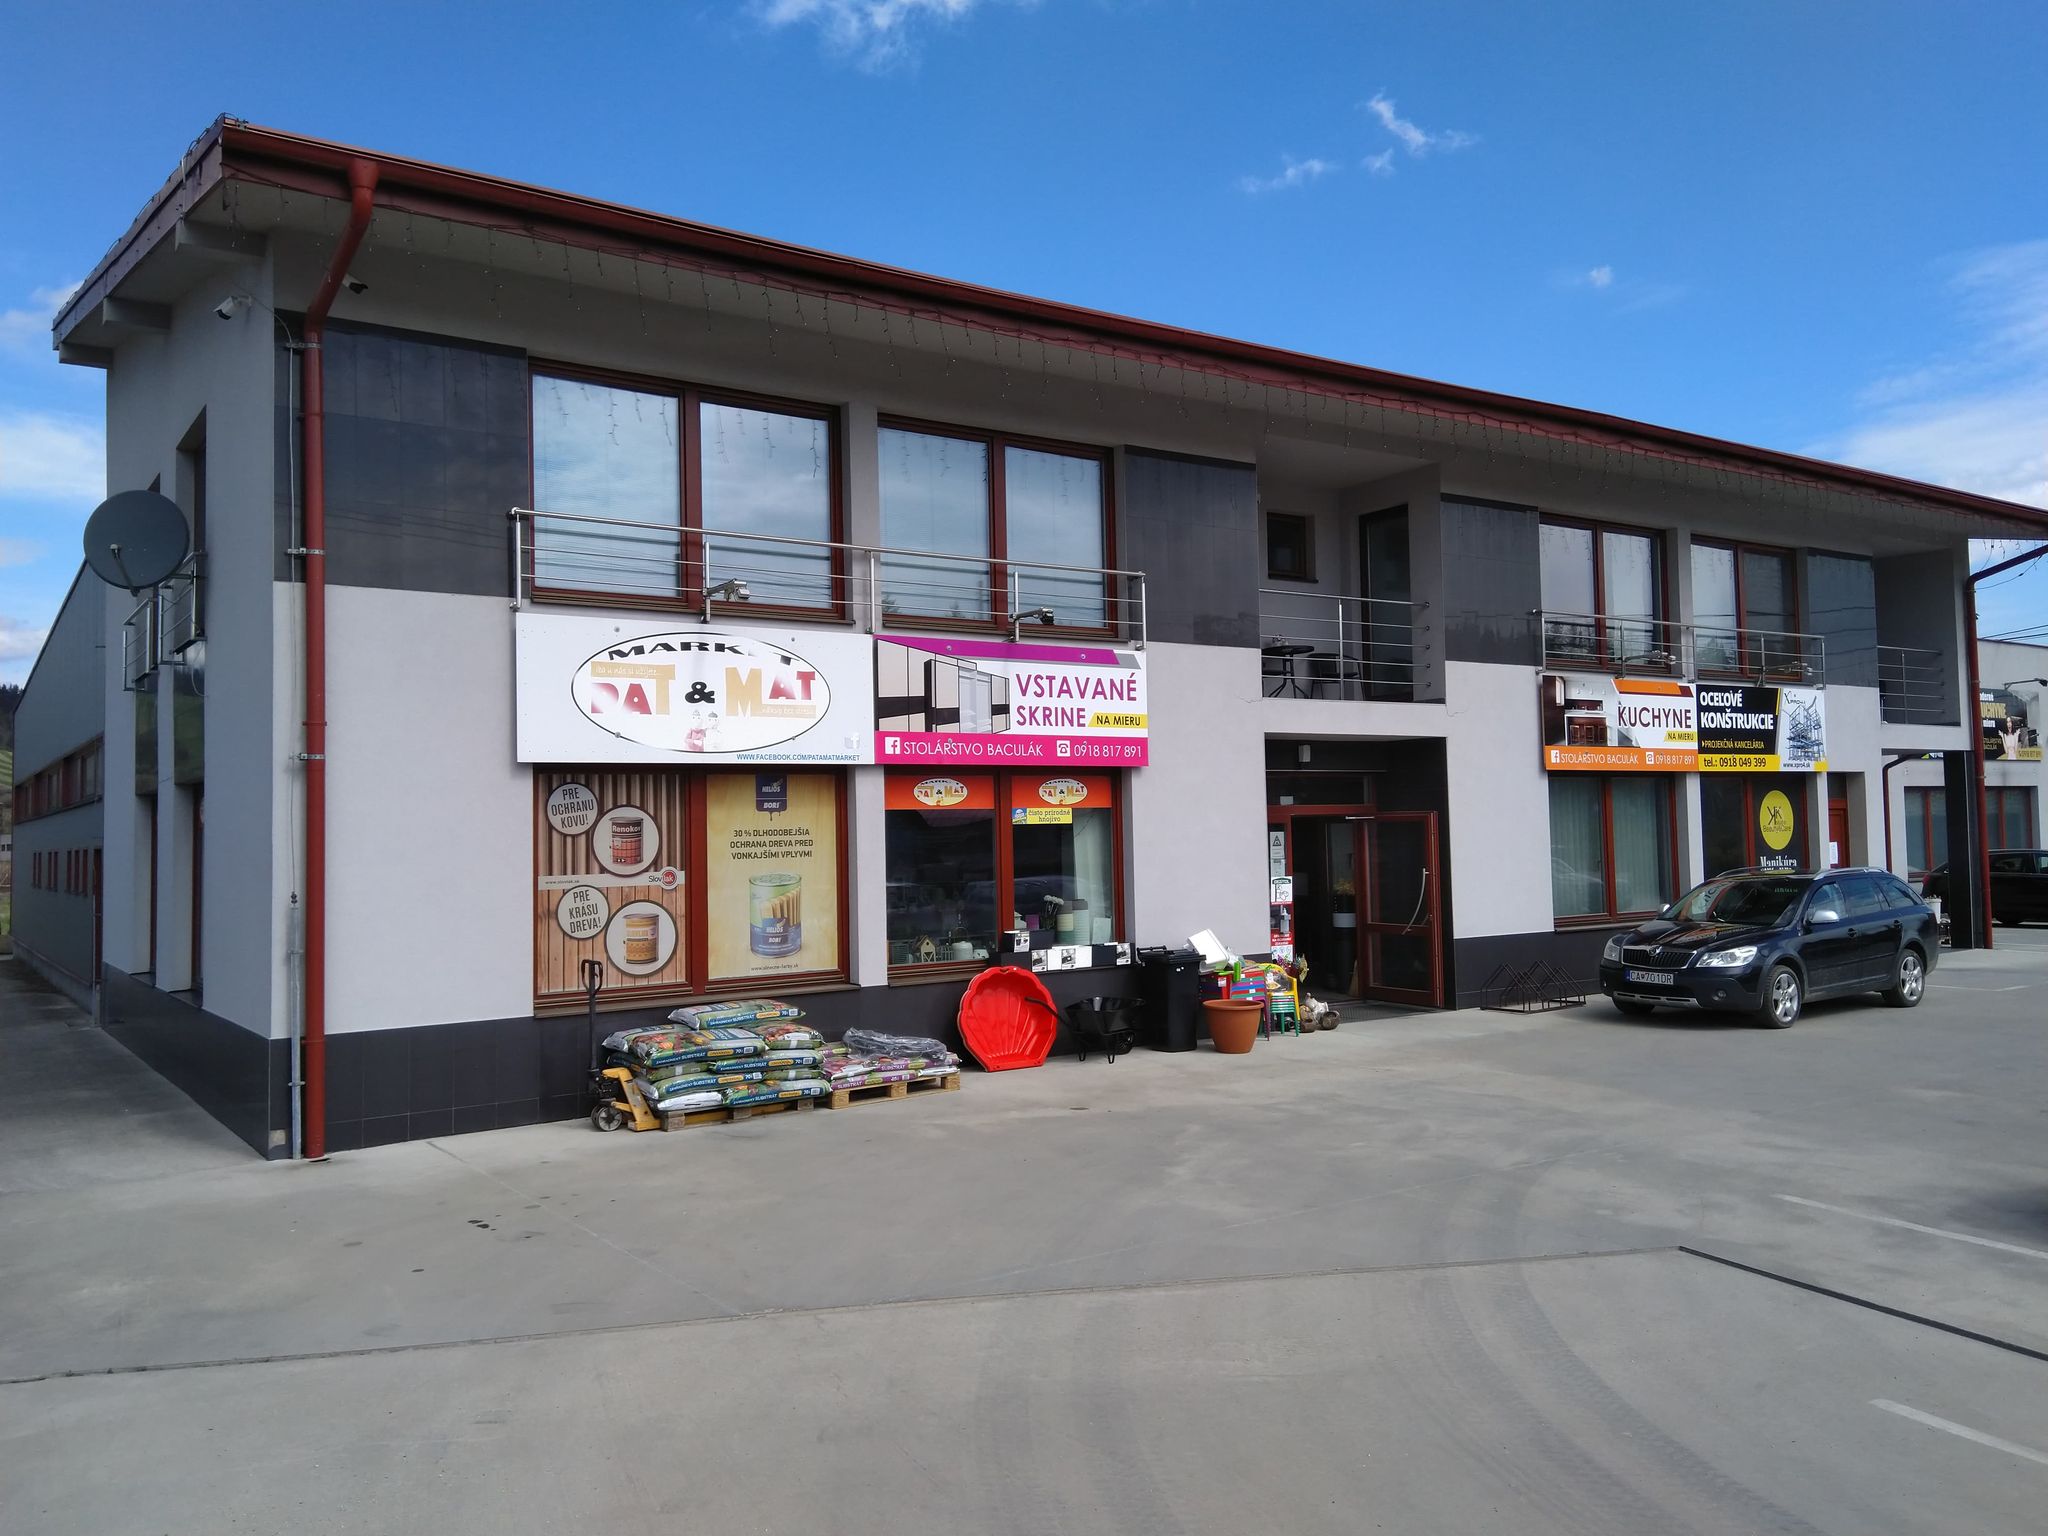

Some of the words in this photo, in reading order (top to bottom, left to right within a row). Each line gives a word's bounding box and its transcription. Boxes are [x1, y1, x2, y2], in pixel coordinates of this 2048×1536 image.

[607, 641, 801, 665] MARKT
[590, 661, 675, 716] PAT
[684, 681, 716, 704] &
[725, 667, 816, 718] MAT
[1016, 672, 1138, 702] VSTAVANÉ
[1700, 689, 1743, 708] OCEĽOVÉ
[1016, 705, 1086, 728] SKRINE
[1096, 716, 1111, 725] NA
[1113, 716, 1141, 726] MIERU
[1617, 705, 1692, 729] KUCHYNE
[1700, 709, 1774, 730] KONŠTRUKCIE
[1667, 732, 1677, 740] NA
[1677, 732, 1694, 741] MIERU
[903, 740, 983, 756] STOLÁRSTVO
[987, 741, 1044, 757] BACULÁK
[1074, 745, 1101, 757] 0918
[1102, 746, 1122, 758] 817
[1124, 746, 1142, 758] 891
[736, 753, 861, 762] WWW.FACEBOOK.COM/PATAMATMARKET
[1560, 751, 1606, 764] STOLÁRSTVO
[1606, 752, 1639, 765] BACULÁK
[1655, 755, 1671, 765] 0918
[1671, 755, 1683, 765] 817
[1684, 756, 1695, 765] 891
[1703, 757, 1718, 767] tel.:
[1719, 756, 1737, 768] 0918
[1738, 757, 1752, 768] 049
[1753, 757, 1767, 768] 399
[562, 787, 580, 800] PRE
[551, 799, 595, 817] OCHRANU
[561, 815, 589, 829] KOVU!
[733, 829, 743, 838] 30
[744, 829, 752, 837] %
[753, 827, 810, 837] DLHODOBEJŠIA
[730, 840, 767, 849] OCHRANA
[768, 840, 793, 848] DREVA
[794, 839, 814, 847] PRED
[780, 850, 813, 859] VPLYVMI
[1760, 855, 1797, 867] Manikúra
[573, 889, 591, 903] PRE
[568, 902, 599, 920] KRÁSU
[570, 916, 601, 934] DREVA!
